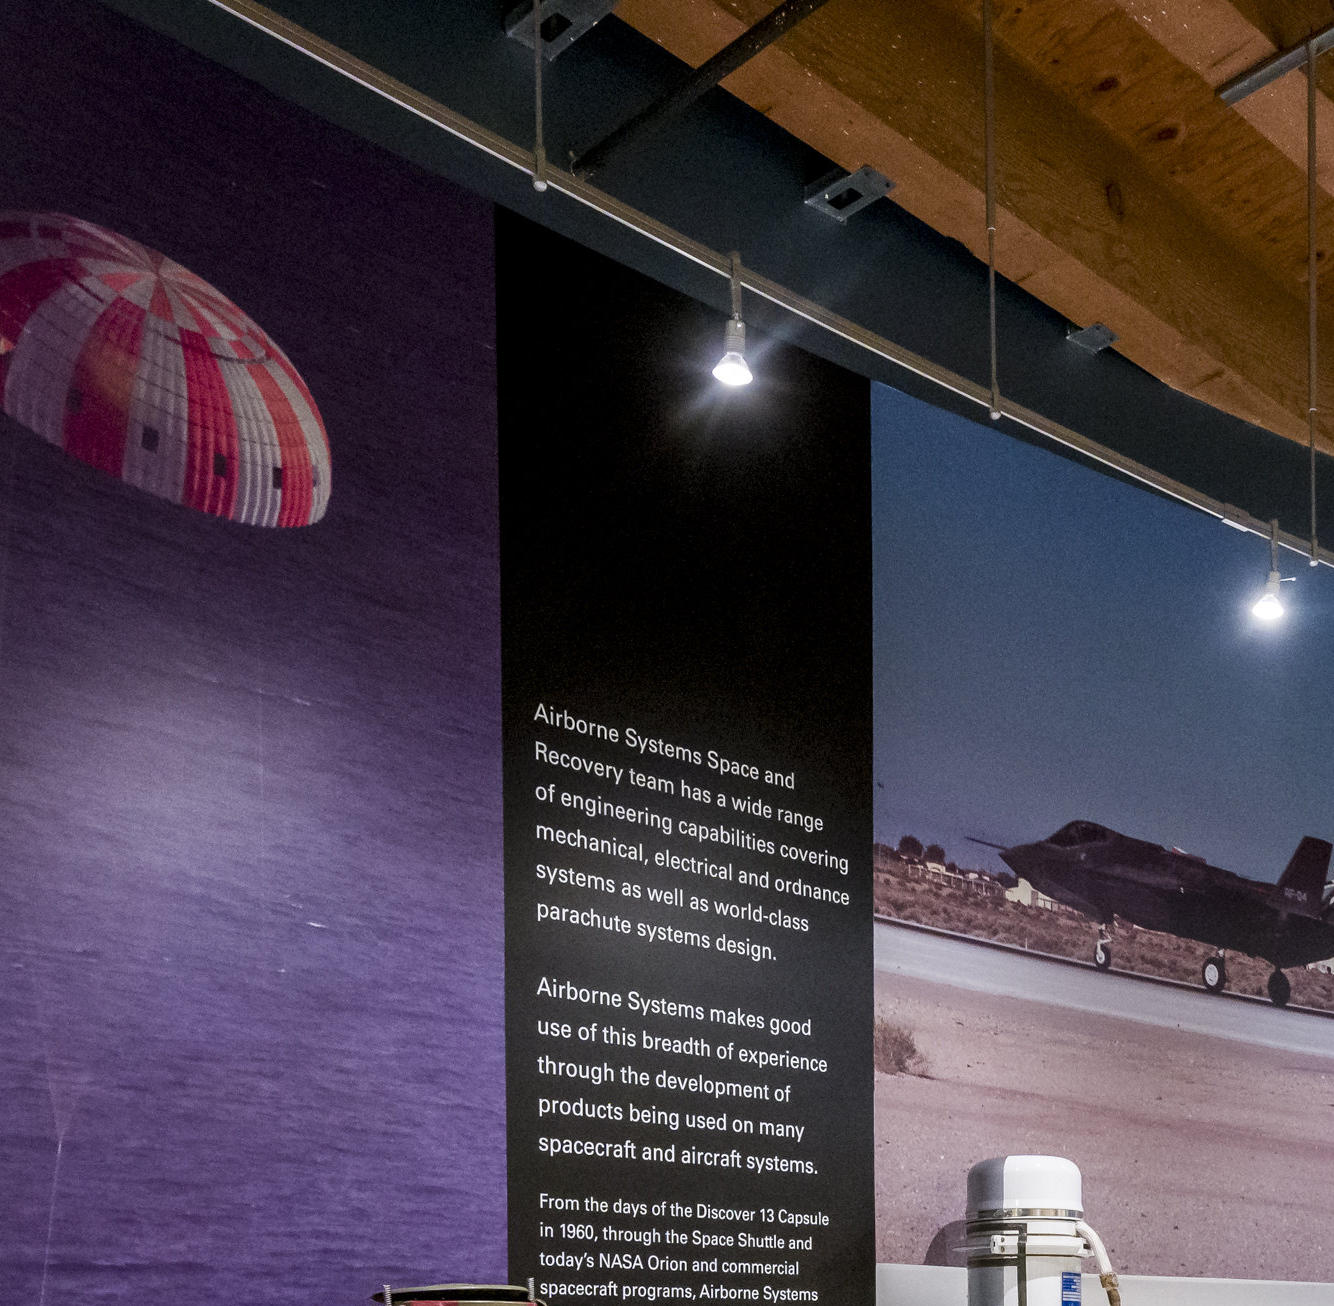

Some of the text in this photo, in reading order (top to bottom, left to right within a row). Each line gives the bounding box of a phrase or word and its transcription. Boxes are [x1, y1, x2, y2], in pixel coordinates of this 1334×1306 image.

[534, 704, 794, 789] Airborne Systems Space and
[536, 741, 823, 832] Recovery team has a wide range
[536, 784, 848, 875] of engineering capabilities covering
[537, 825, 849, 905] mechanical, electrical and ordnance
[537, 864, 808, 931] systems as well as world-class
[538, 903, 776, 961] parachute systems design.
[537, 977, 811, 1035] Airborne Systems makes good
[538, 1021, 827, 1072] use of this breadth of experience
[537, 1055, 791, 1102] through the development of
[539, 1098, 804, 1142] products being used on many
[539, 1138, 817, 1174] spacecraft and aircraft systems.
[540, 1193, 829, 1227] From the days of the Discover 13 Capsule
[540, 1222, 812, 1250] in 1960, through the Space Shuttle and
[540, 1252, 798, 1275] today's NASA Orion and commercial
[540, 1281, 818, 1303] spacecraft programs, Airborne Systems
